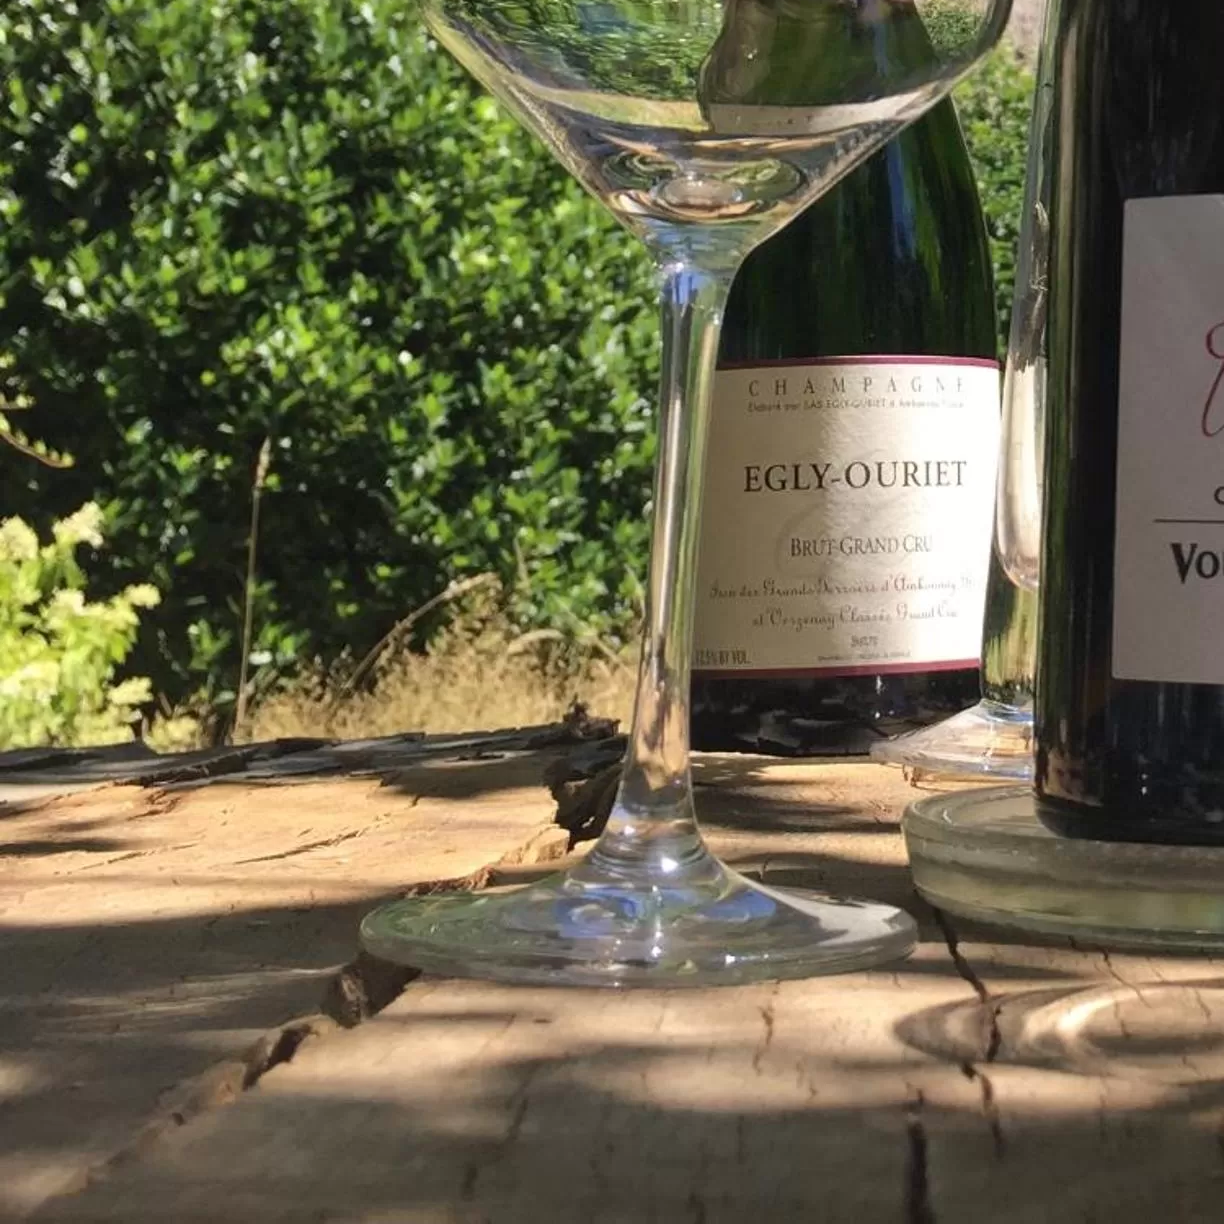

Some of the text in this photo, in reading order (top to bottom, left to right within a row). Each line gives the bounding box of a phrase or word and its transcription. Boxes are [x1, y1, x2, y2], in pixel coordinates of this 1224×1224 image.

[748, 376, 964, 397] CHAMPAGNE
[743, 460, 967, 493] EGLY-OURIET
[790, 533, 933, 557] BRUT GRAND CRU
